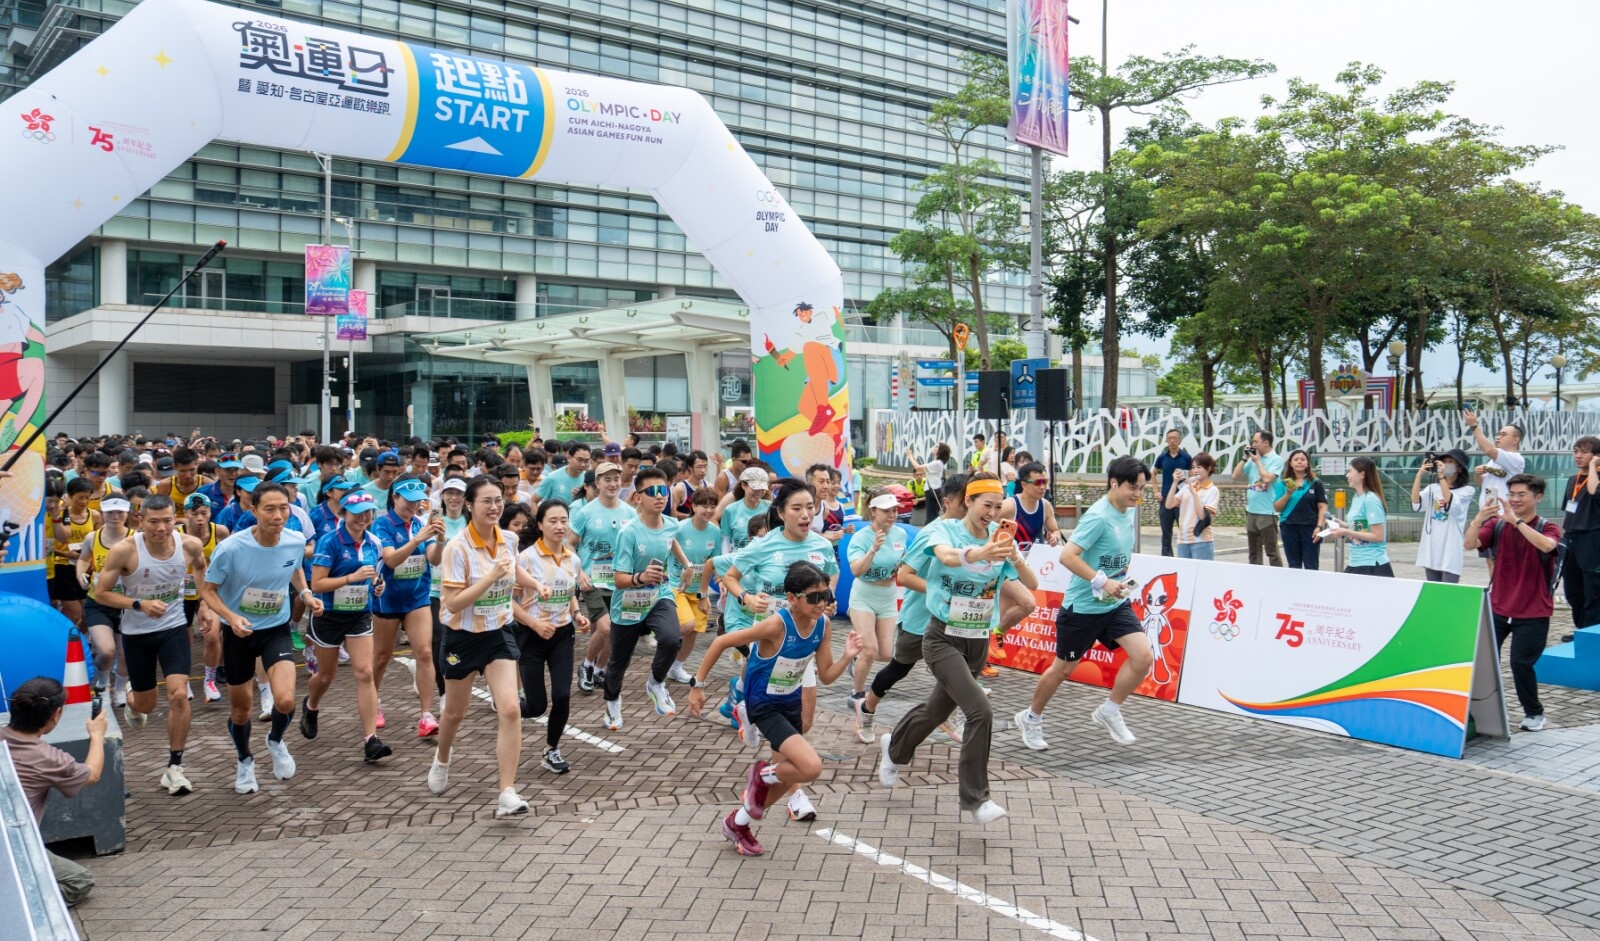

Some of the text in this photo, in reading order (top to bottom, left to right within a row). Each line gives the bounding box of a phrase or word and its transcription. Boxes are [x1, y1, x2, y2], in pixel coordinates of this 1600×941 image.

[256, 20, 289, 33] 2026
[232, 21, 395, 98] 奧運日
[429, 52, 529, 106] 起點
[565, 87, 589, 98] 2026
[434, 96, 530, 133] START
[567, 98, 681, 125] OLYMPIC DAY
[568, 117, 652, 134] CUM AICHI-NAGOYA
[88, 126, 114, 153] 75
[567, 126, 663, 145] ASIAN GAMES FUN RUN
[756, 211, 785, 222] OLYMPIC
[765, 222, 779, 232] DAY
[254, 600, 276, 609] 3181
[632, 600, 651, 608] 3123
[962, 612, 983, 621] 3131
[1022, 621, 1057, 637] AICHI-
[1275, 612, 1305, 648] 75
[1307, 637, 1362, 652] ANNIVERSARY
[1088, 648, 1115, 664] RUN
